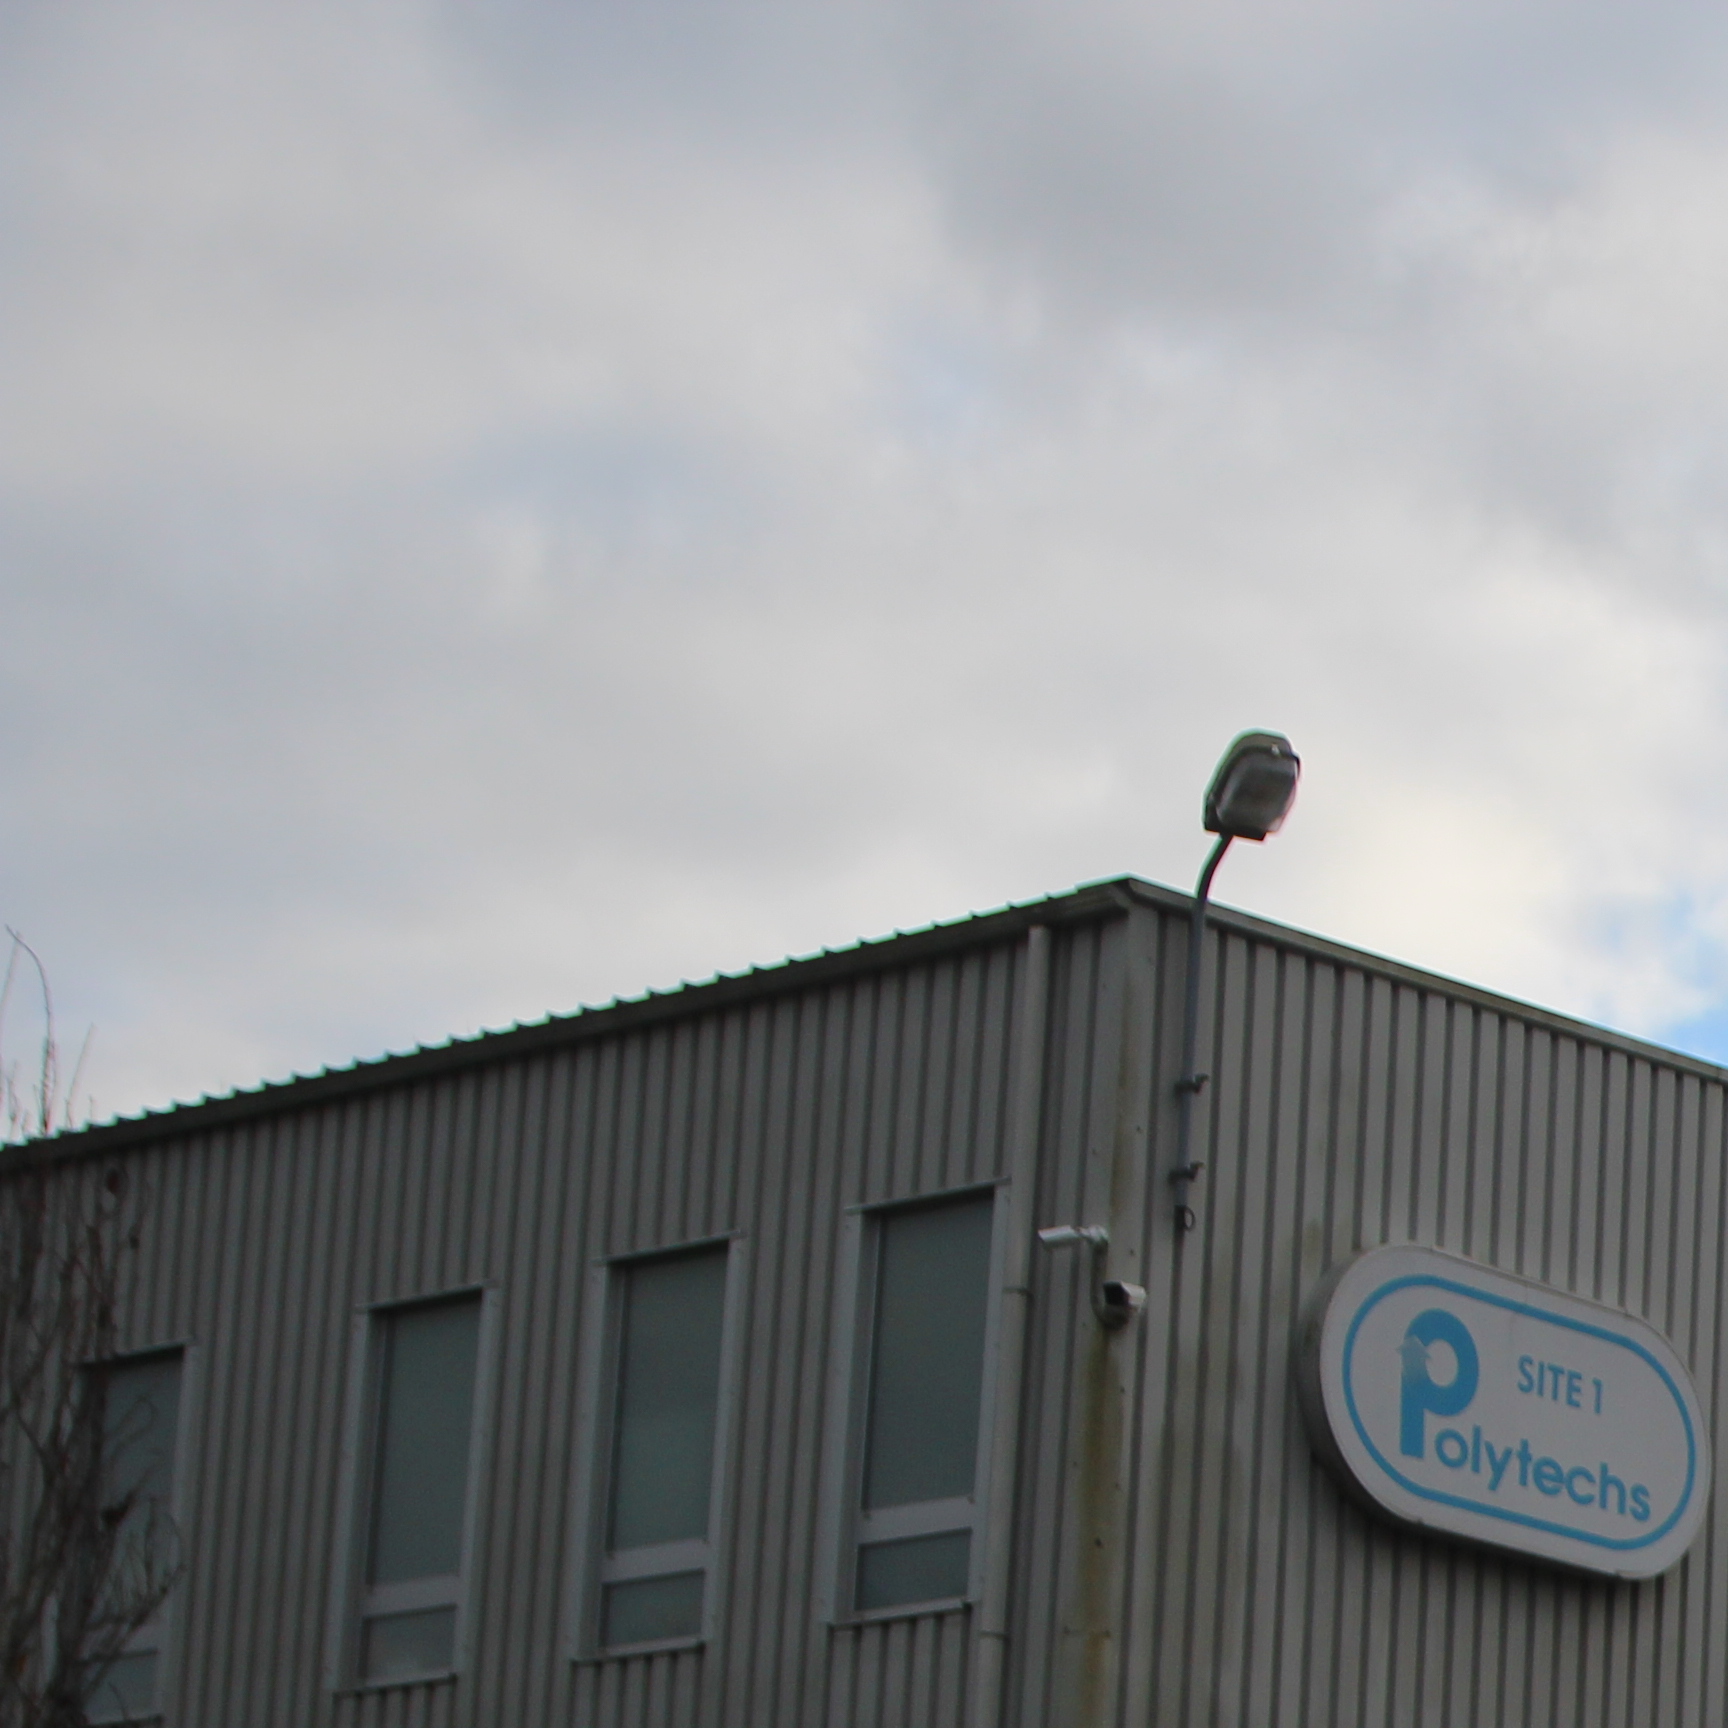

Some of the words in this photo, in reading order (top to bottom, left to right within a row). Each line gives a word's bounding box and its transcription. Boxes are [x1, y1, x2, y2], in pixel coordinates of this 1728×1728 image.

[1400, 1308, 1651, 1522] Polytechs
[1517, 1355, 1582, 1408] SITE
[1592, 1377, 1604, 1415] 1
